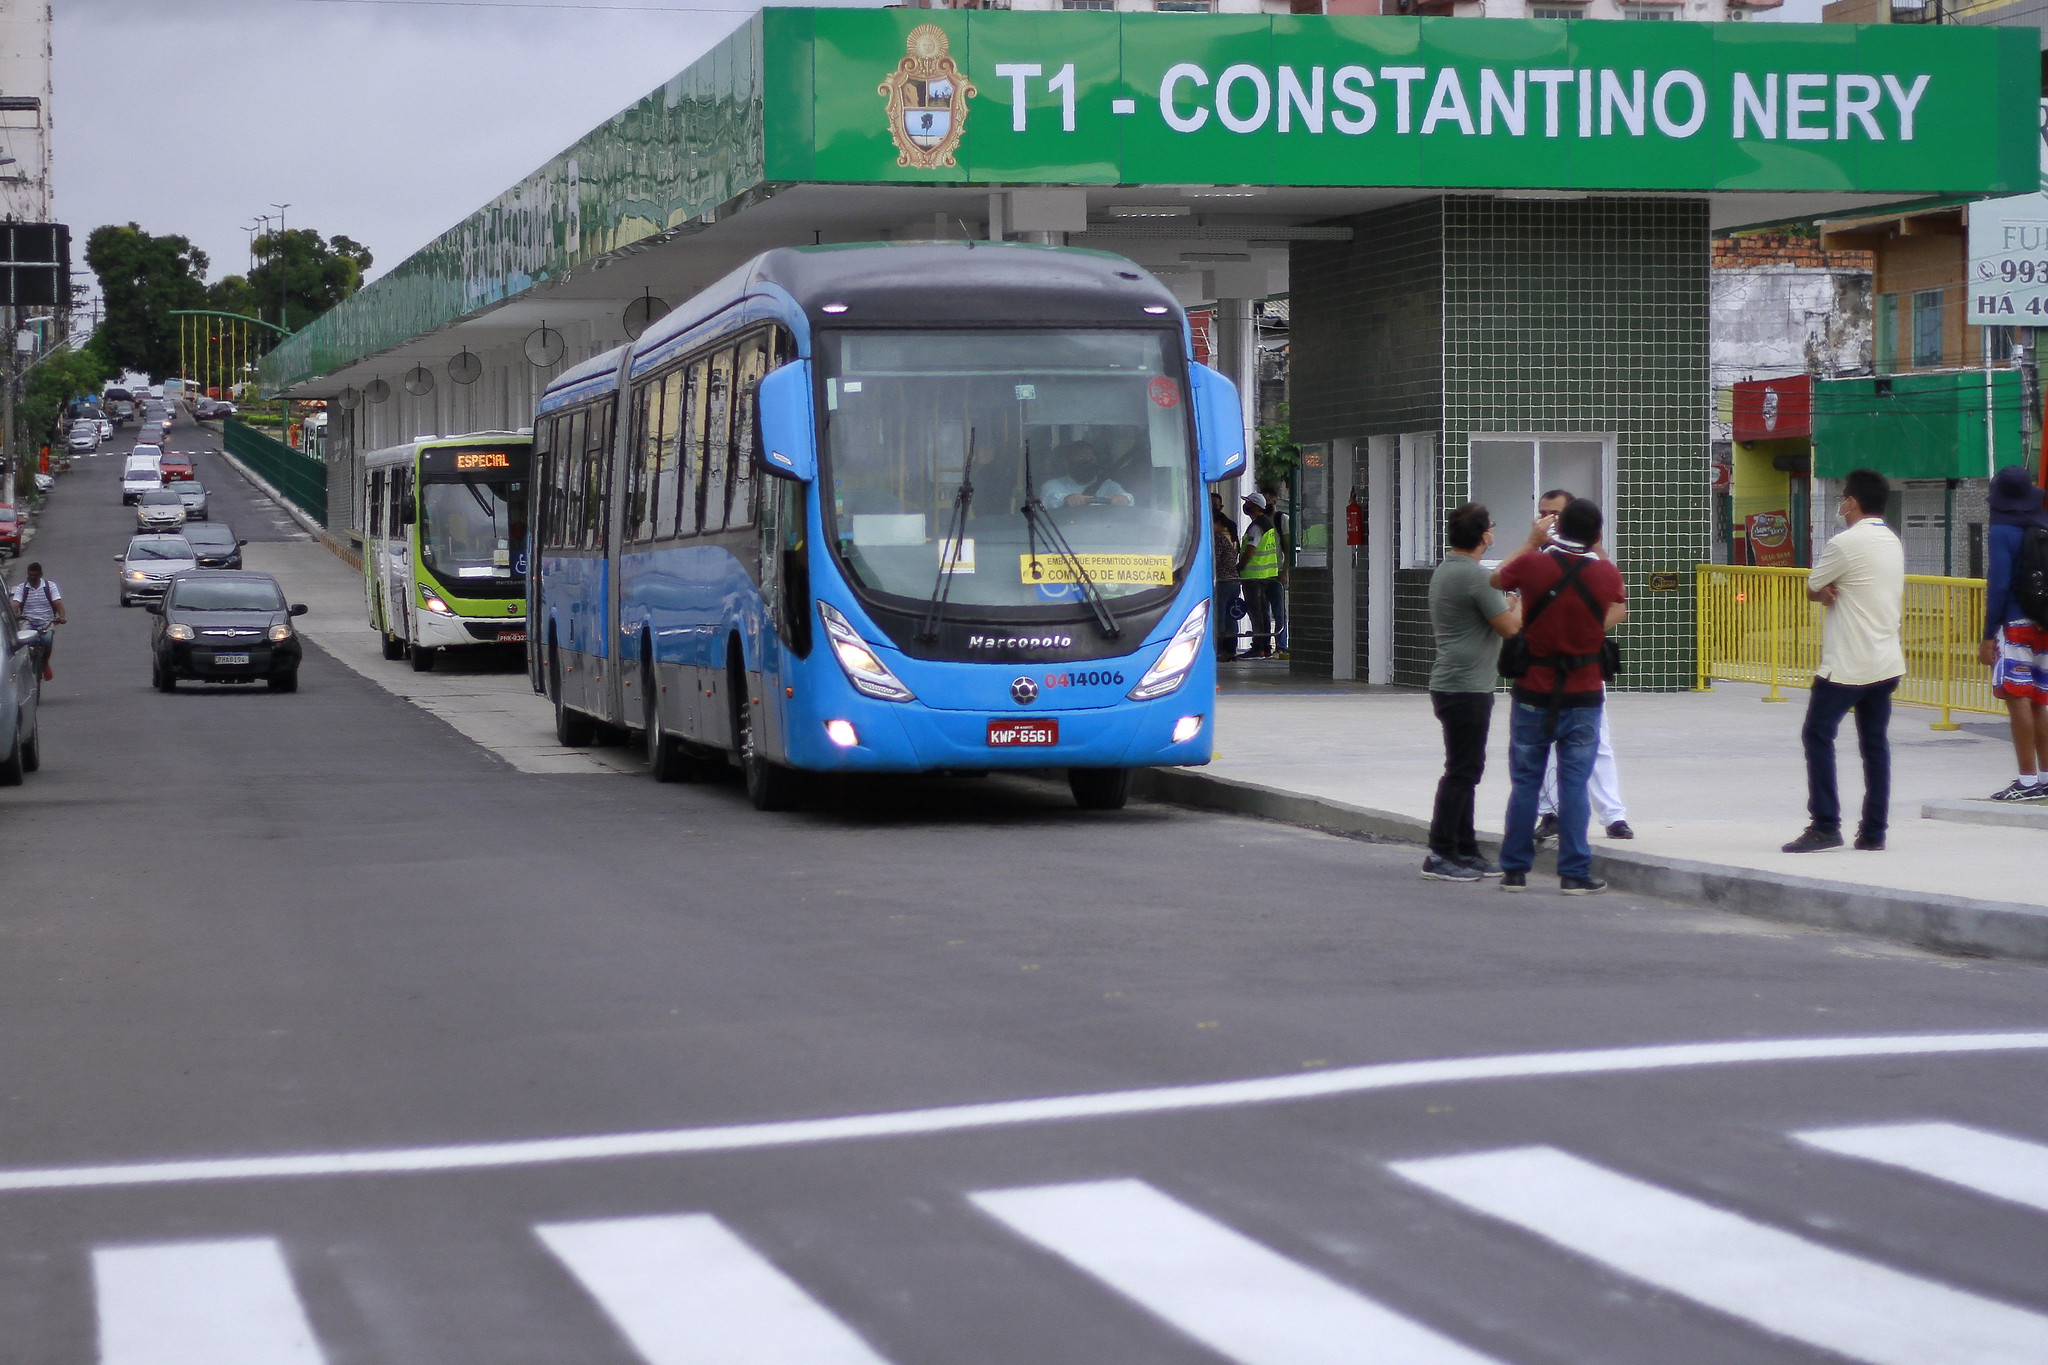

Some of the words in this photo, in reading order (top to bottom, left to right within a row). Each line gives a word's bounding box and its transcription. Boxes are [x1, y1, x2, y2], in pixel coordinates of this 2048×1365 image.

[995, 63, 1076, 132] T1
[1159, 63, 1706, 138] CONSTANTINO
[1733, 72, 1931, 141] NERY
[2002, 226, 2048, 251] FU
[457, 454, 510, 468] ESPECIAL
[1092, 557, 1132, 565] PERMITIDO
[1133, 558, 1168, 566] SOMENTE
[1048, 570, 1075, 581] COM
[1100, 570, 1115, 580] DE
[968, 635, 1072, 649] Marcopolo
[1044, 670, 1125, 689] 0414006
[991, 730, 1052, 743] KWP-6561
